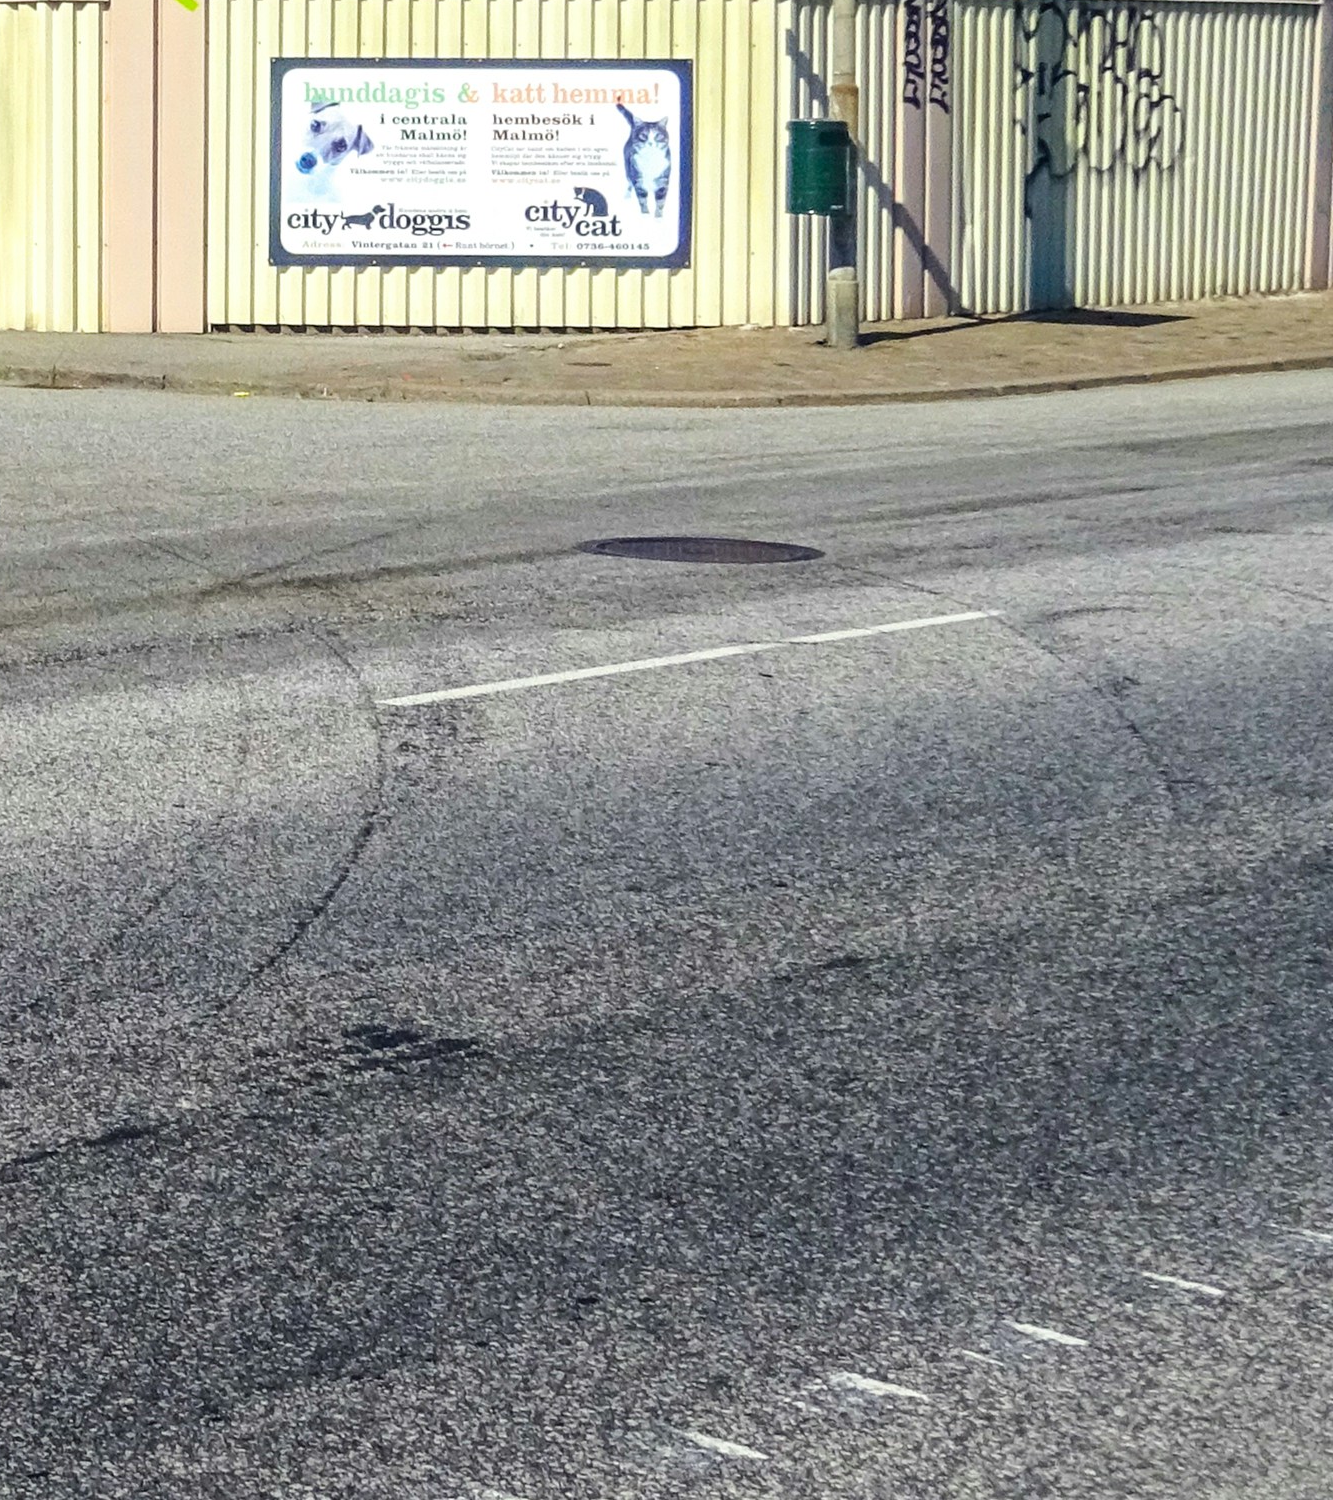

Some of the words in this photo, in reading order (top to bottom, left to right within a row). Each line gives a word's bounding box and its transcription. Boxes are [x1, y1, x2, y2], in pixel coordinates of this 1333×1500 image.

[304, 82, 445, 109] hunddagis
[458, 82, 479, 104] &
[492, 83, 546, 104] katt
[552, 83, 659, 104] hemma!
[380, 113, 386, 125] i
[392, 113, 468, 125] centrala
[493, 113, 583, 125] hembesök
[589, 114, 595, 125] i
[401, 129, 467, 141] Malmö!
[493, 129, 560, 141] Malmö!
[287, 208, 341, 235] city
[379, 202, 471, 237] doggis
[524, 199, 582, 229] city
[575, 214, 622, 237] cat
[352, 240, 418, 251] Vintergatan
[576, 242, 651, 251] 0736-460145
